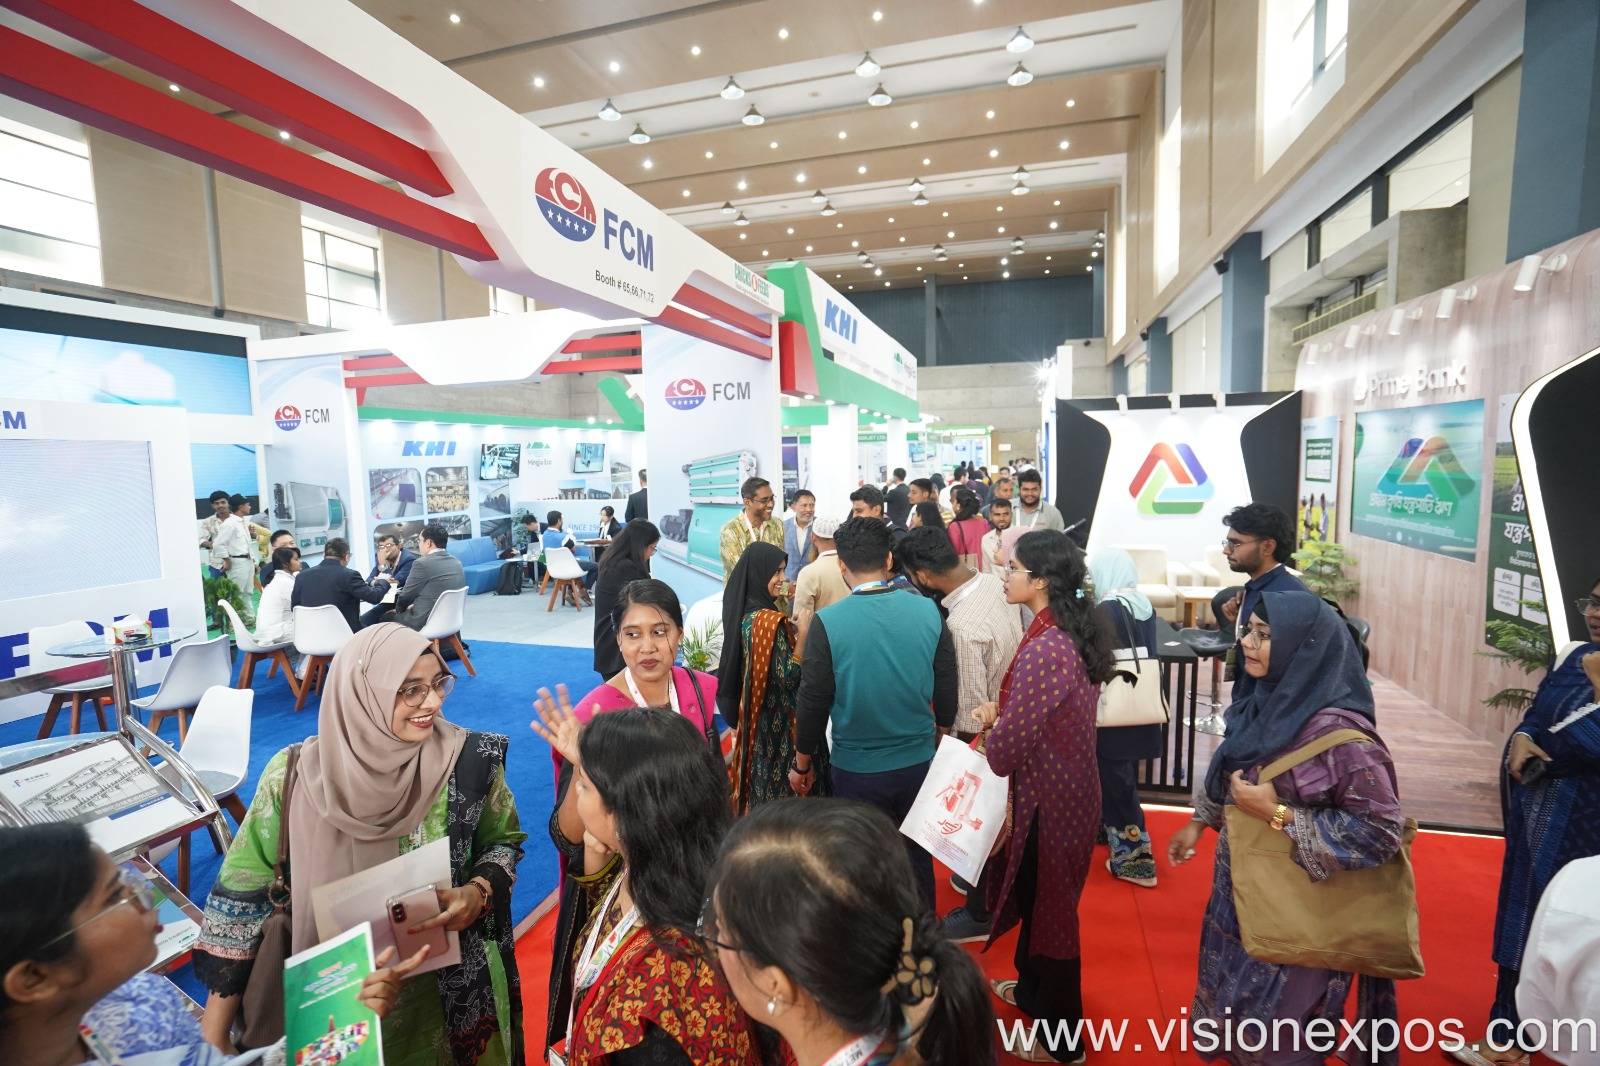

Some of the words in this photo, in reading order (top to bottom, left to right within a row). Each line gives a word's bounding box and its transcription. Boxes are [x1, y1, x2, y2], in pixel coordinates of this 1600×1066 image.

[603, 207, 654, 272] FCM
[595, 269, 616, 288] Booth
[617, 279, 622, 289] #
[824, 298, 858, 344] KHI
[1416, 360, 1468, 393] Bank
[712, 381, 751, 401] FCM
[0, 410, 27, 429] M
[305, 408, 330, 424] FCM
[402, 441, 457, 456] KHI
[1511, 494, 1525, 512] প্রা
